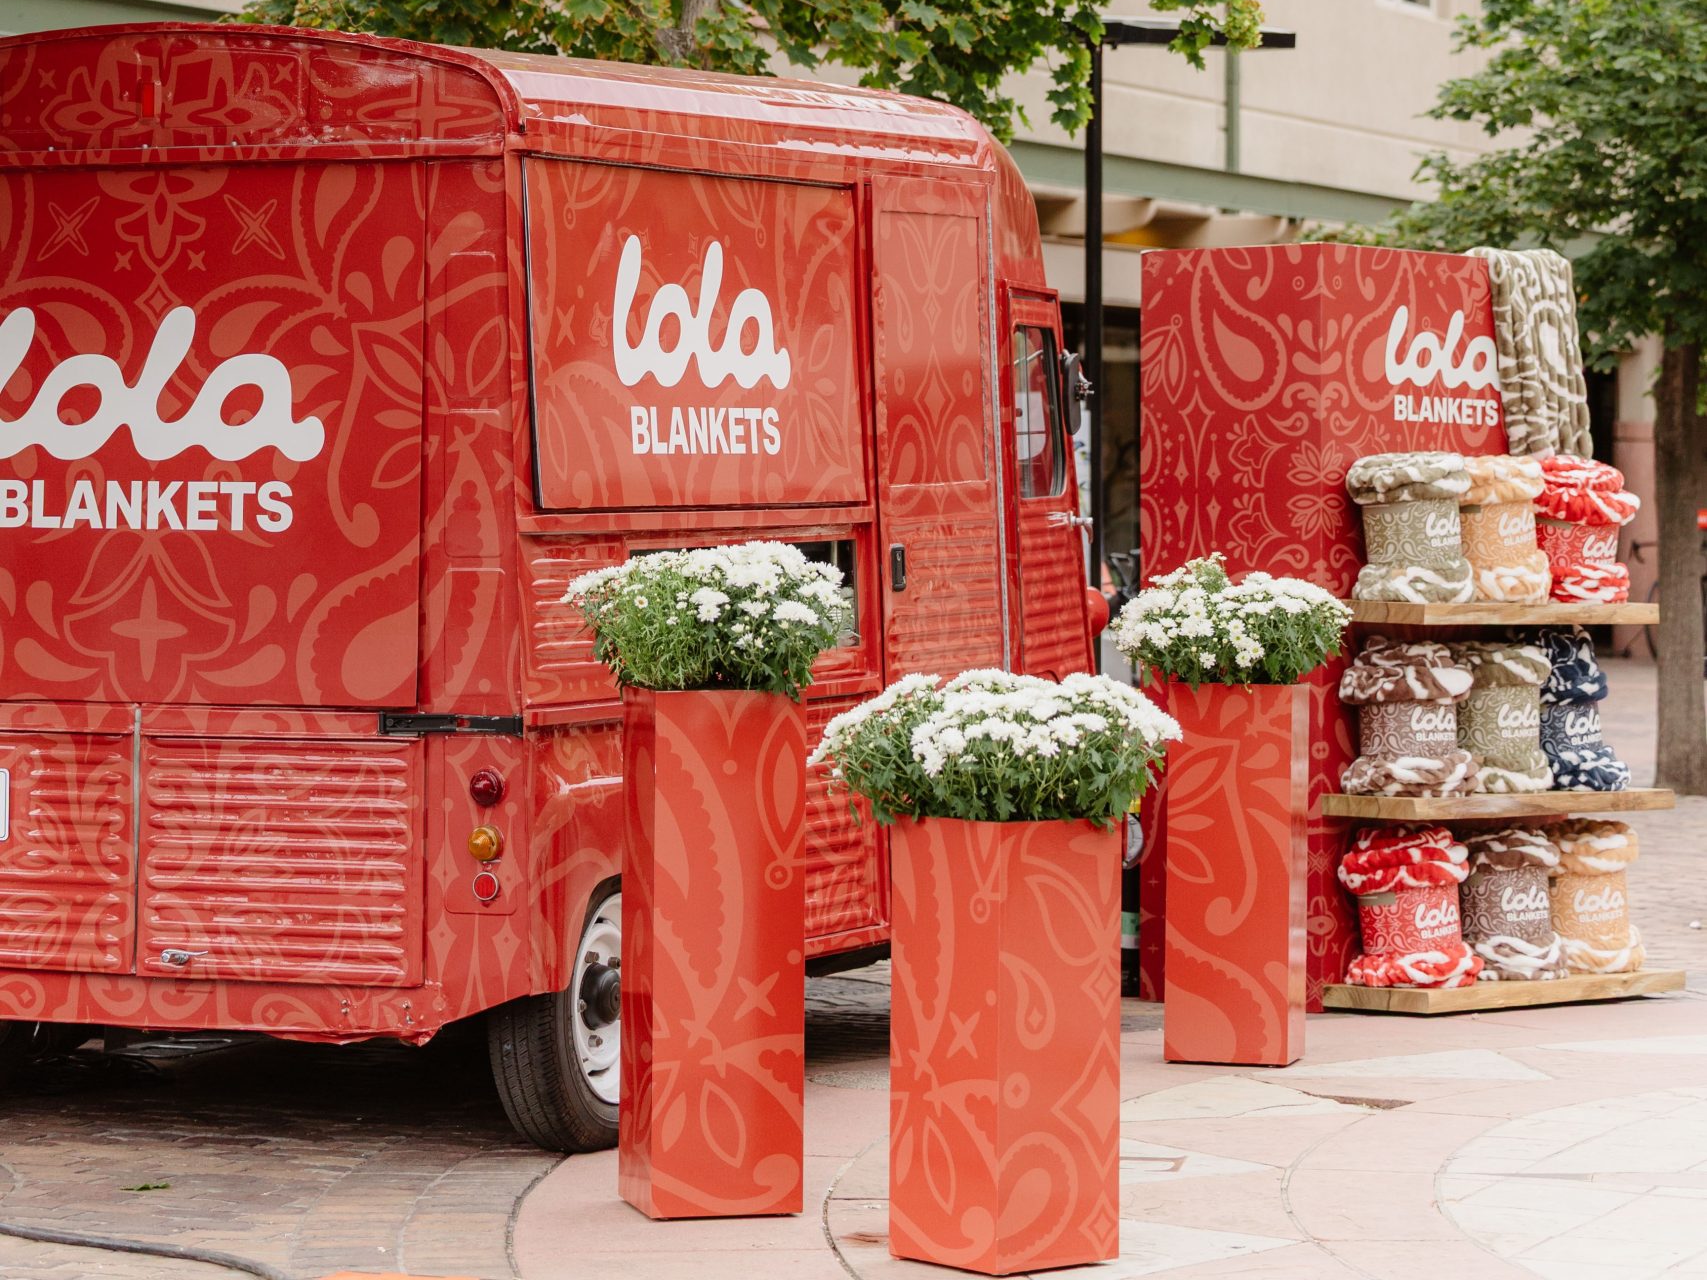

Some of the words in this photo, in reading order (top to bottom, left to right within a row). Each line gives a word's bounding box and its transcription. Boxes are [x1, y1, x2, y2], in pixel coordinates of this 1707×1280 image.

[612, 234, 791, 390] lola
[1385, 305, 1500, 391] lola
[1393, 393, 1499, 427] BLANKETS
[630, 406, 781, 455] BLANKETS
[0, 479, 294, 533] BLANKETS
[1411, 705, 1457, 732] lola
[1414, 898, 1459, 929] lola
[1501, 884, 1550, 912] lola
[1574, 885, 1625, 913] lola
